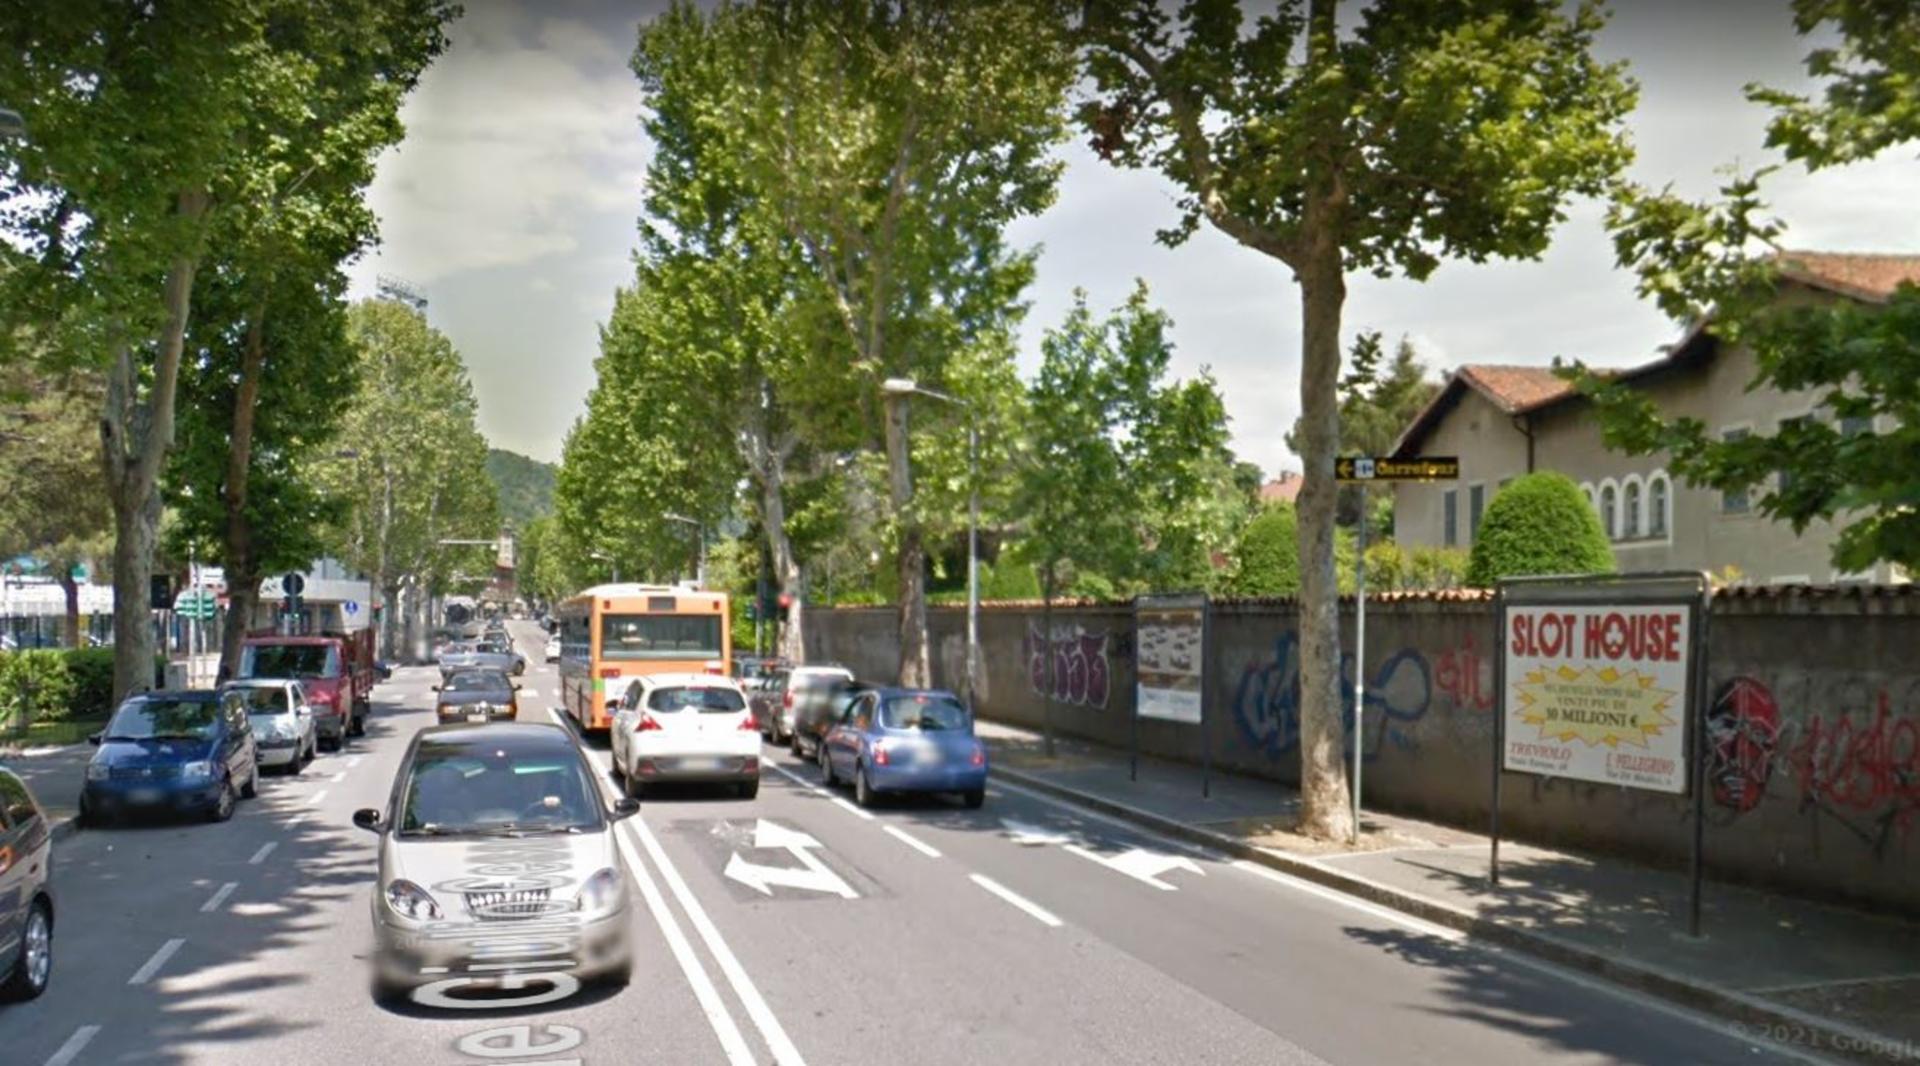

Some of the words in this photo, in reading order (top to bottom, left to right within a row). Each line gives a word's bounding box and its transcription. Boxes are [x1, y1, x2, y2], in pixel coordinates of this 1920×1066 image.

[1511, 612, 1577, 659] SLOT
[1584, 612, 1682, 662] HOUSE
[1562, 708, 1627, 727] MILIONI
